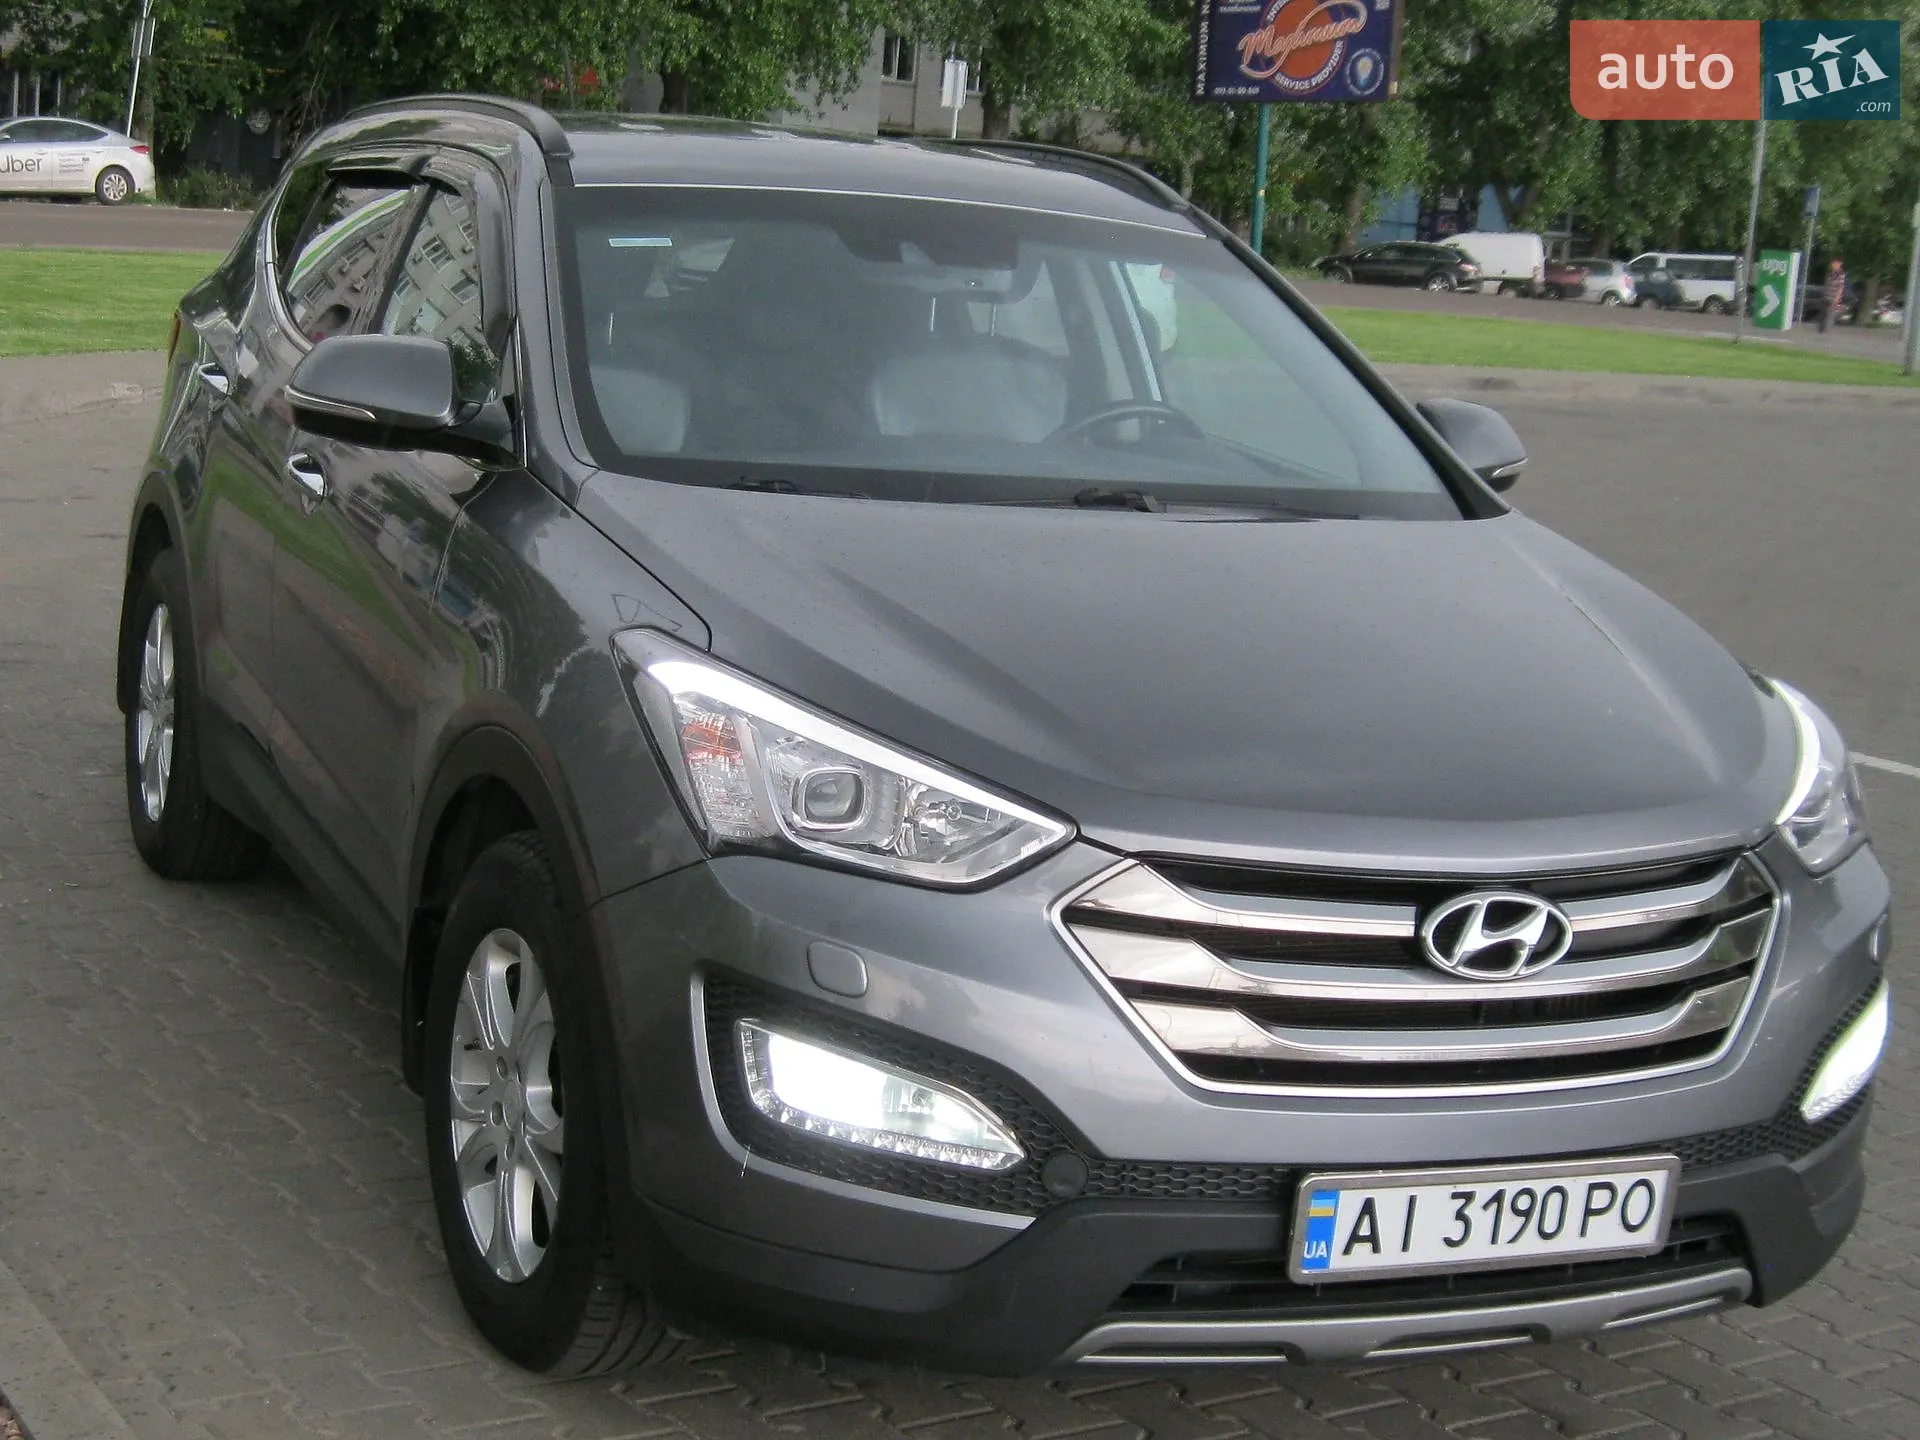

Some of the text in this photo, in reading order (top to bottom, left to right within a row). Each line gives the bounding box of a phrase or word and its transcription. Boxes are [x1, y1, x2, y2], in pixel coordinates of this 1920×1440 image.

[1195, 21, 1209, 95] MAXIMUM
[1274, 72, 1311, 90] SERVICE
[1311, 40, 1344, 86] PROVIDER
[1343, 1178, 1656, 1256] AI 3190 PO
[1303, 1240, 1328, 1259] UA
